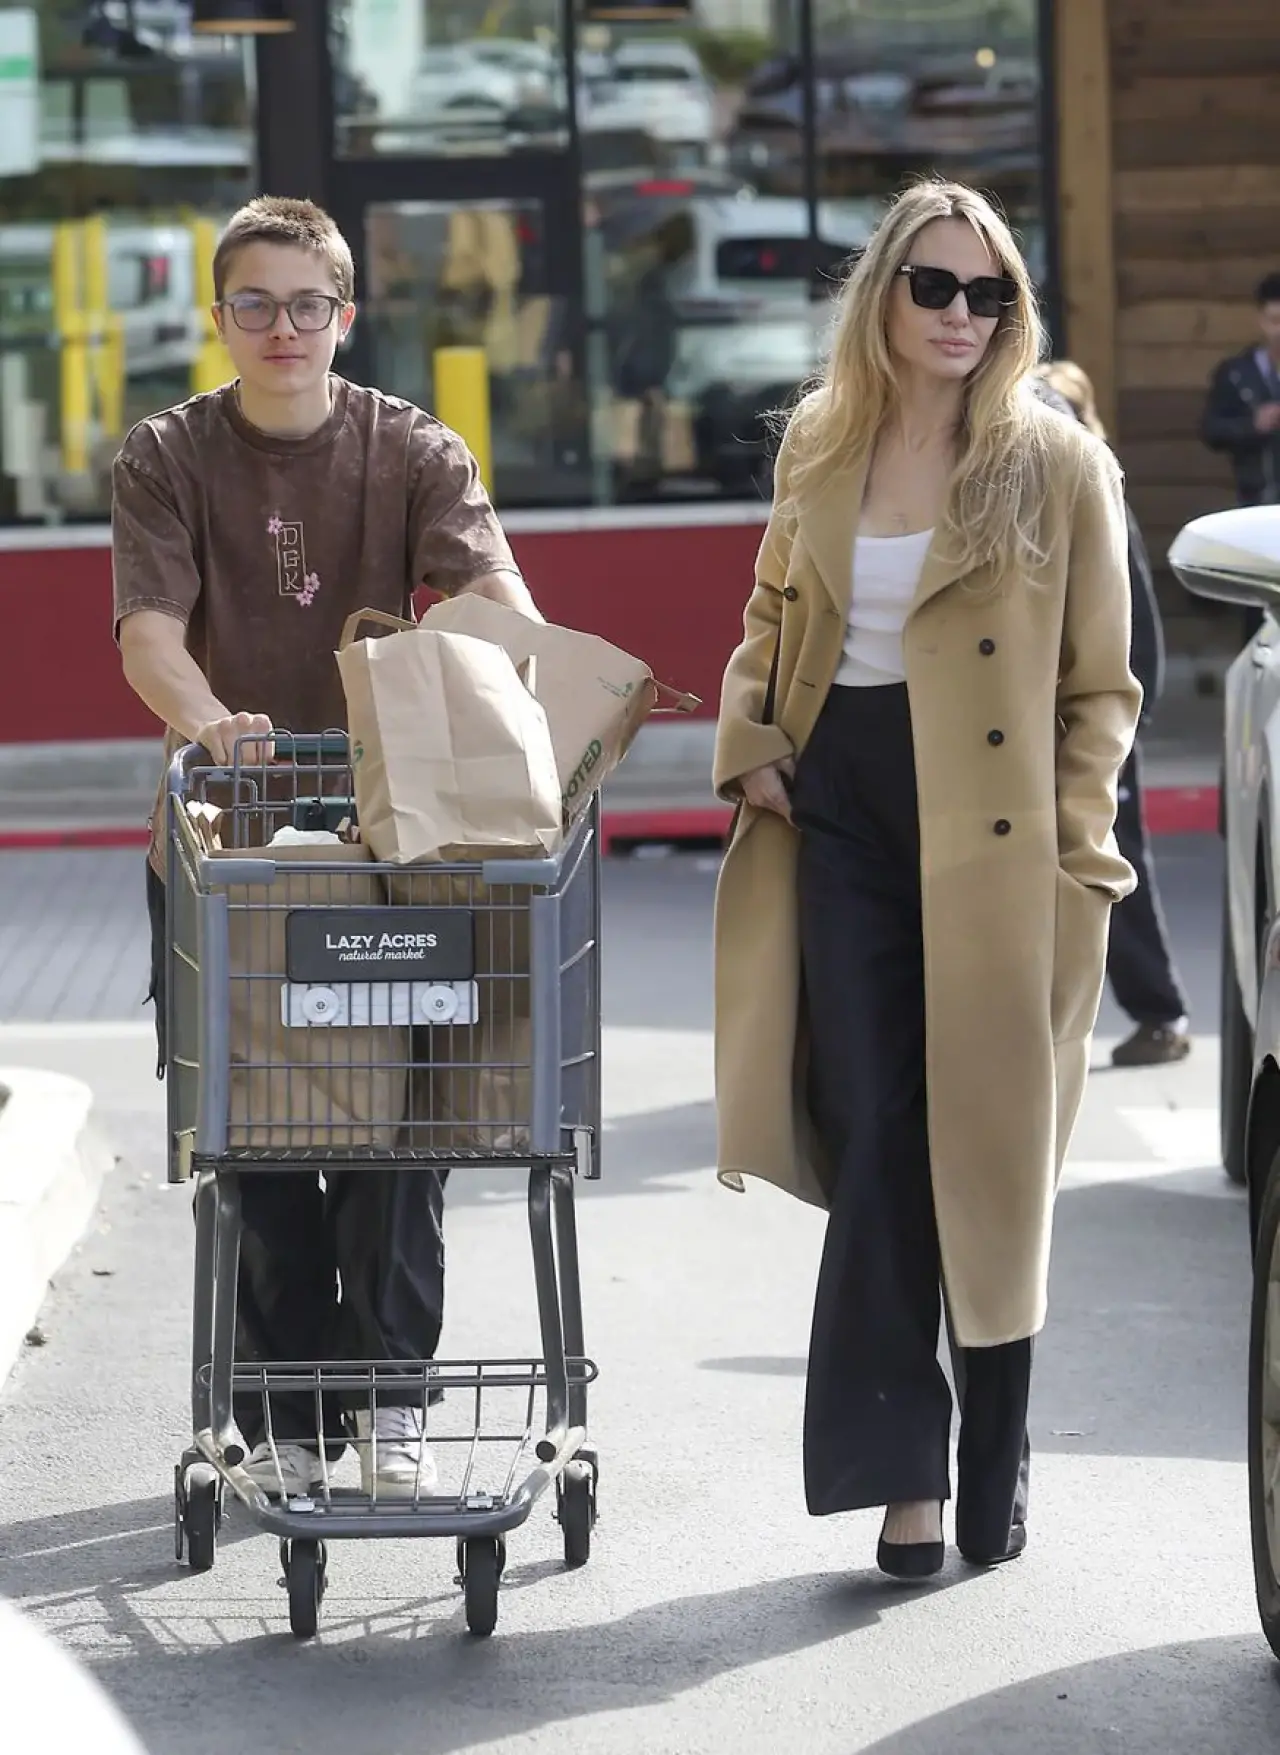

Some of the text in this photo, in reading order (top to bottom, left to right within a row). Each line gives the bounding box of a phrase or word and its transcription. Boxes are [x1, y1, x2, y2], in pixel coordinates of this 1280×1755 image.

[282, 527, 301, 590] DGK
[325, 932, 437, 949] LAZY ACRES
[339, 948, 426, 961] natural market
